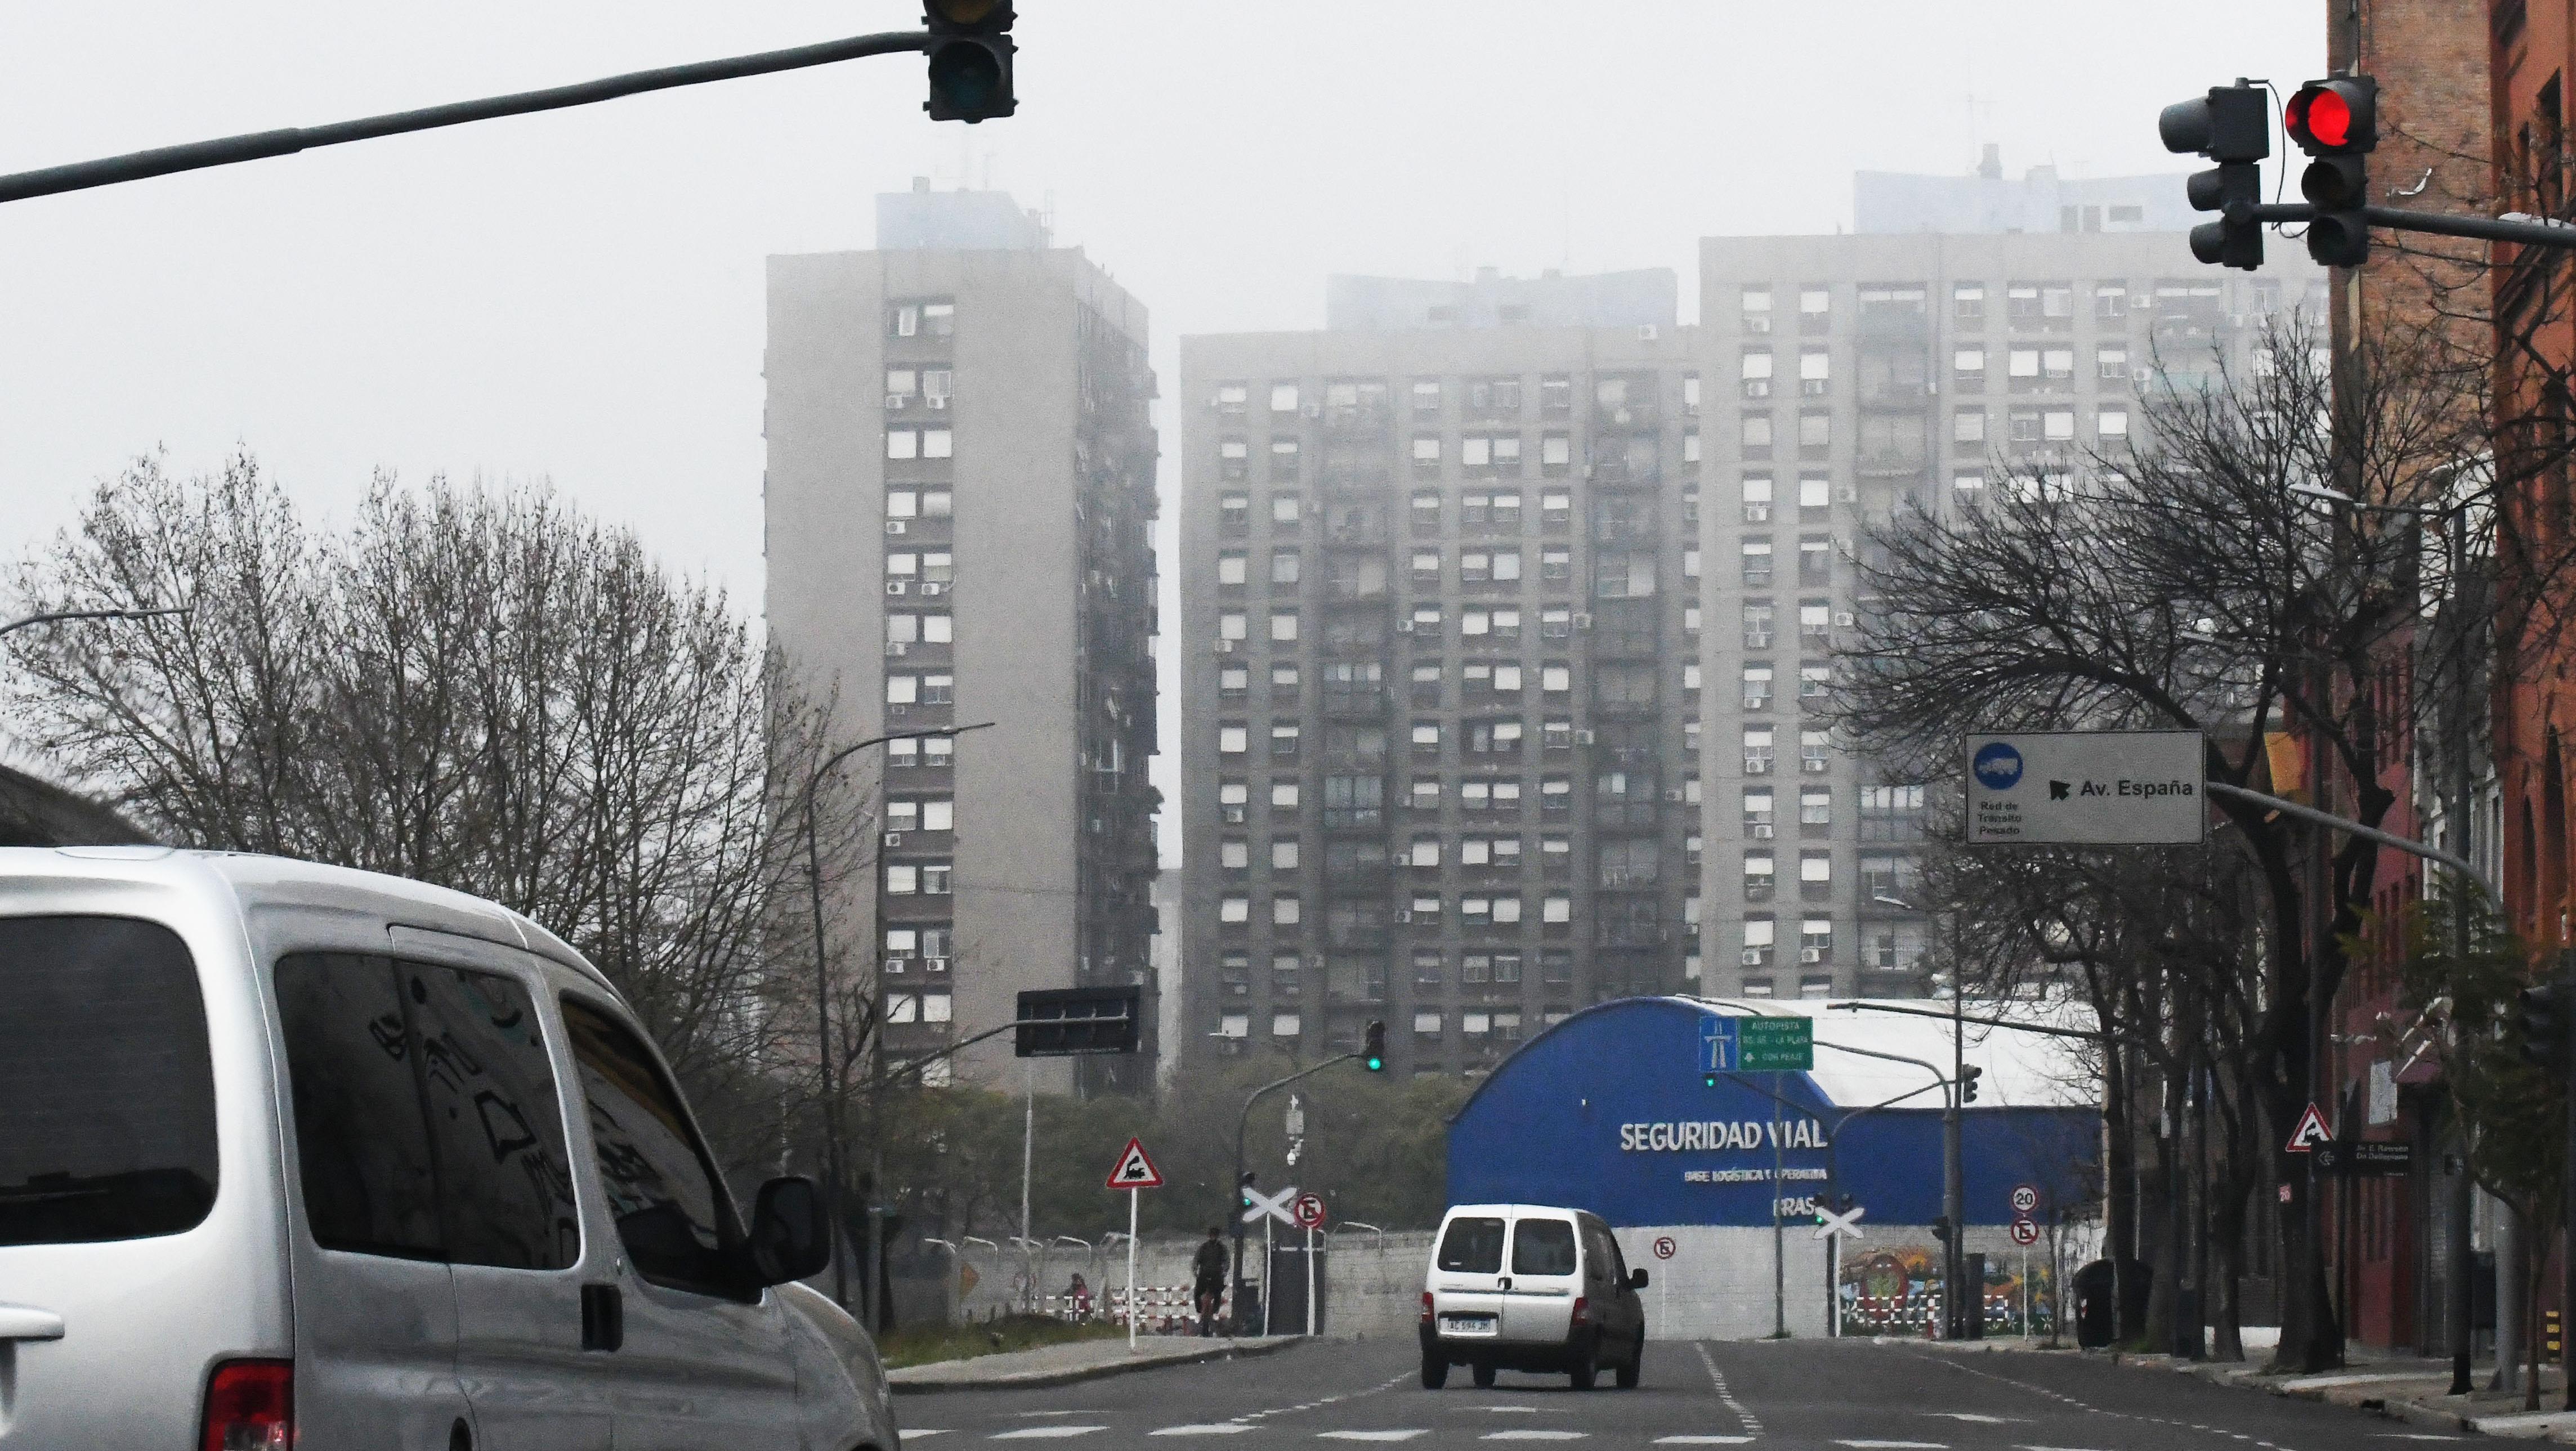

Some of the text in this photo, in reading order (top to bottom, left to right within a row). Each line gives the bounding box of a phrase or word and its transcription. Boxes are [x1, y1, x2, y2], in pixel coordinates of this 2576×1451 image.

[2081, 780, 2193, 799] Av. España
[1981, 801, 2002, 810] Red
[1752, 1022, 1799, 1030] AUTOPISTA
[1620, 1119, 1828, 1151] SEGURIDAD VIAL
[2016, 1193, 2033, 1204] 20
